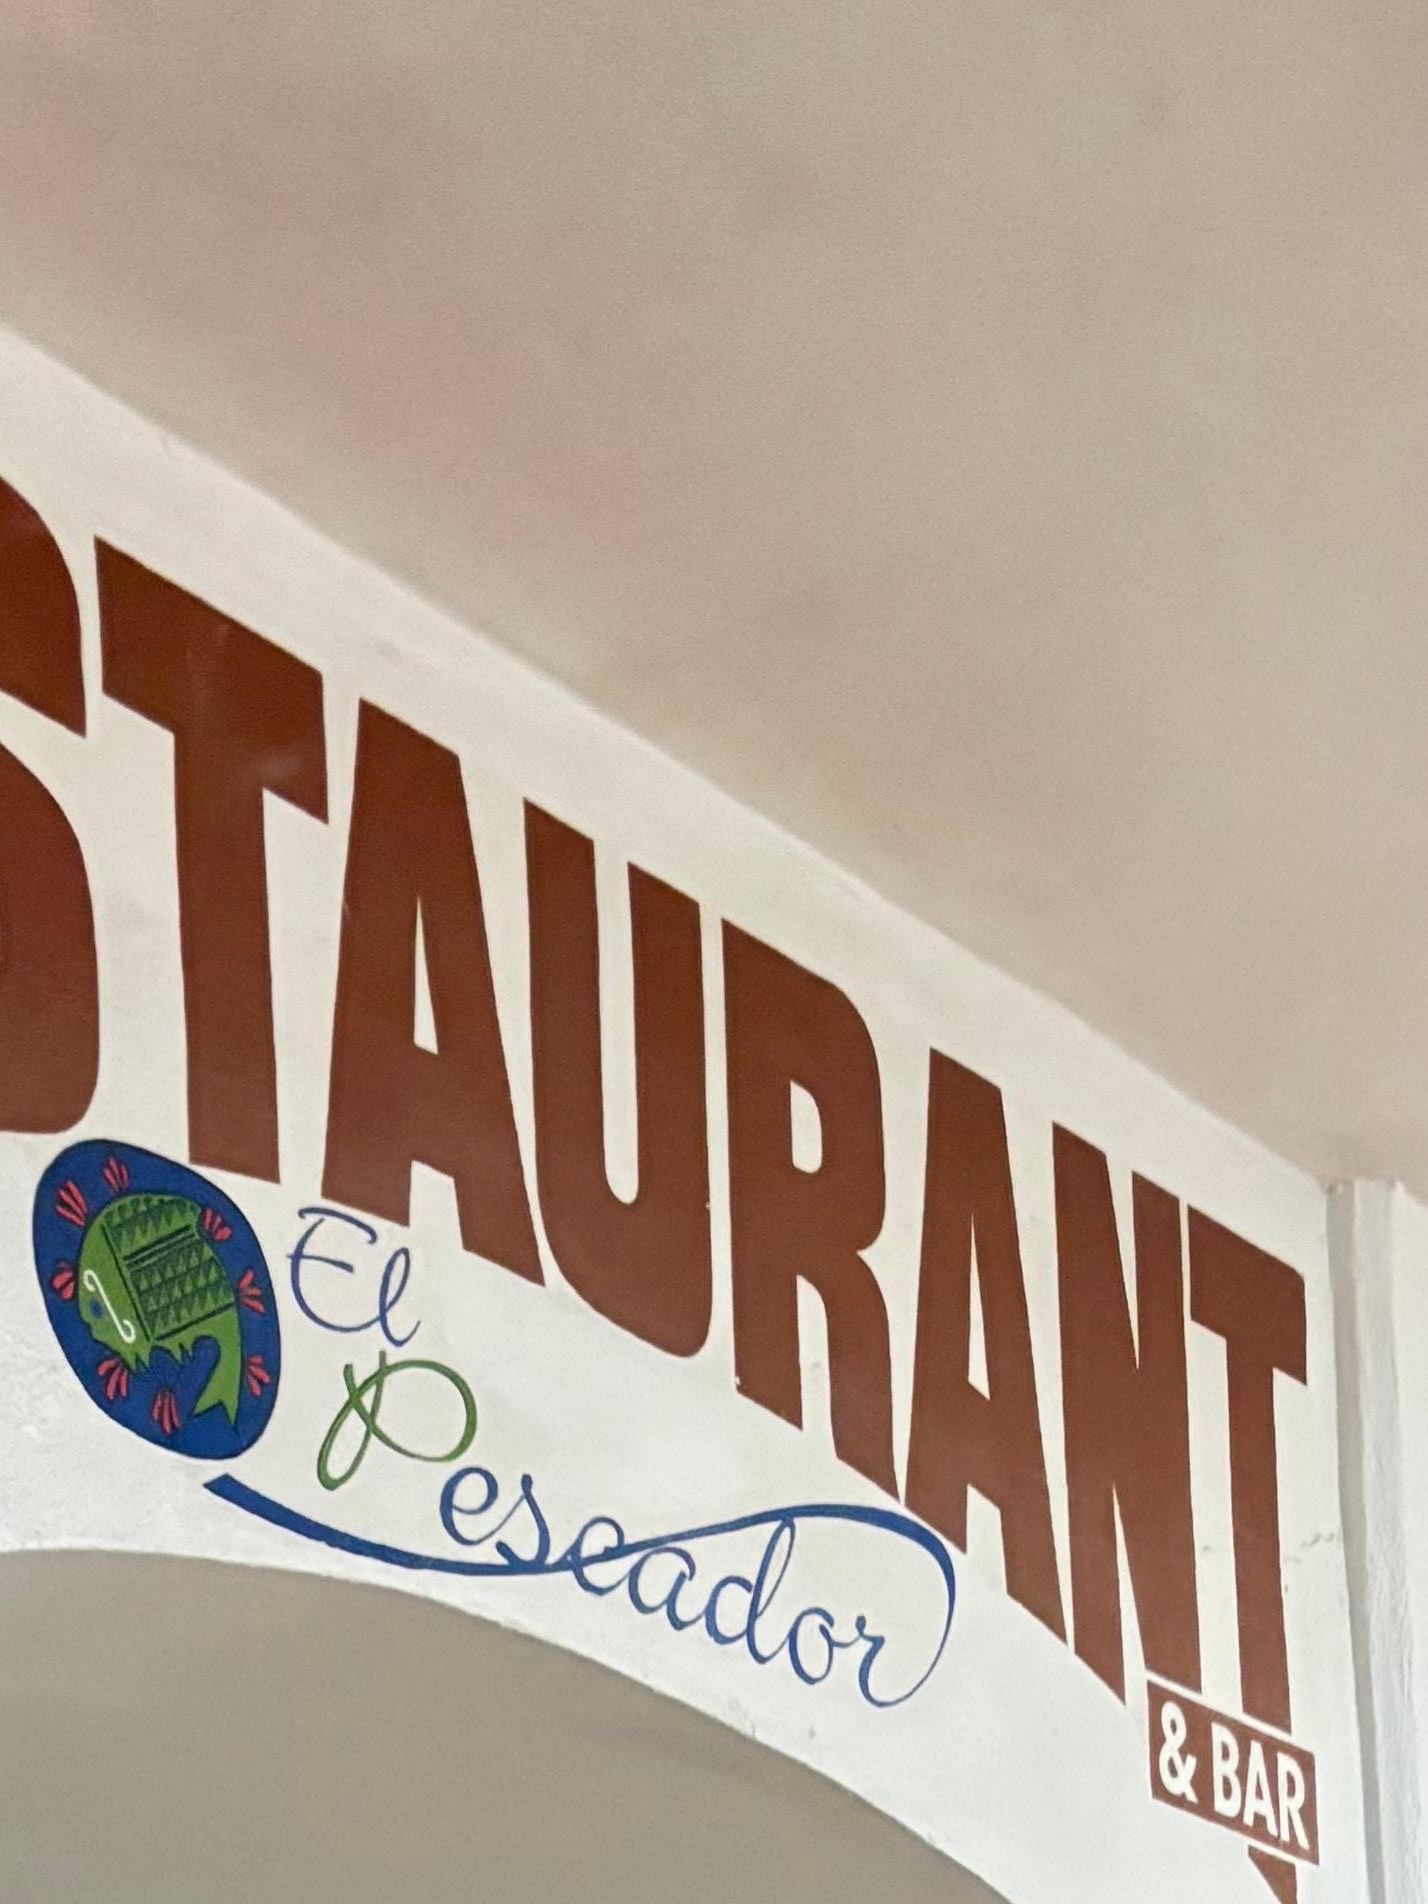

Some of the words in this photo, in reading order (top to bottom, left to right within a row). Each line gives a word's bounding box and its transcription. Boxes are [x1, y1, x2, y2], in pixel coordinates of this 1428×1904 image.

[285, 1206, 421, 1348] El
[316, 1350, 902, 1709] Pescador
[1158, 1700, 1199, 1805] &
[1210, 1720, 1311, 1851] BAR
